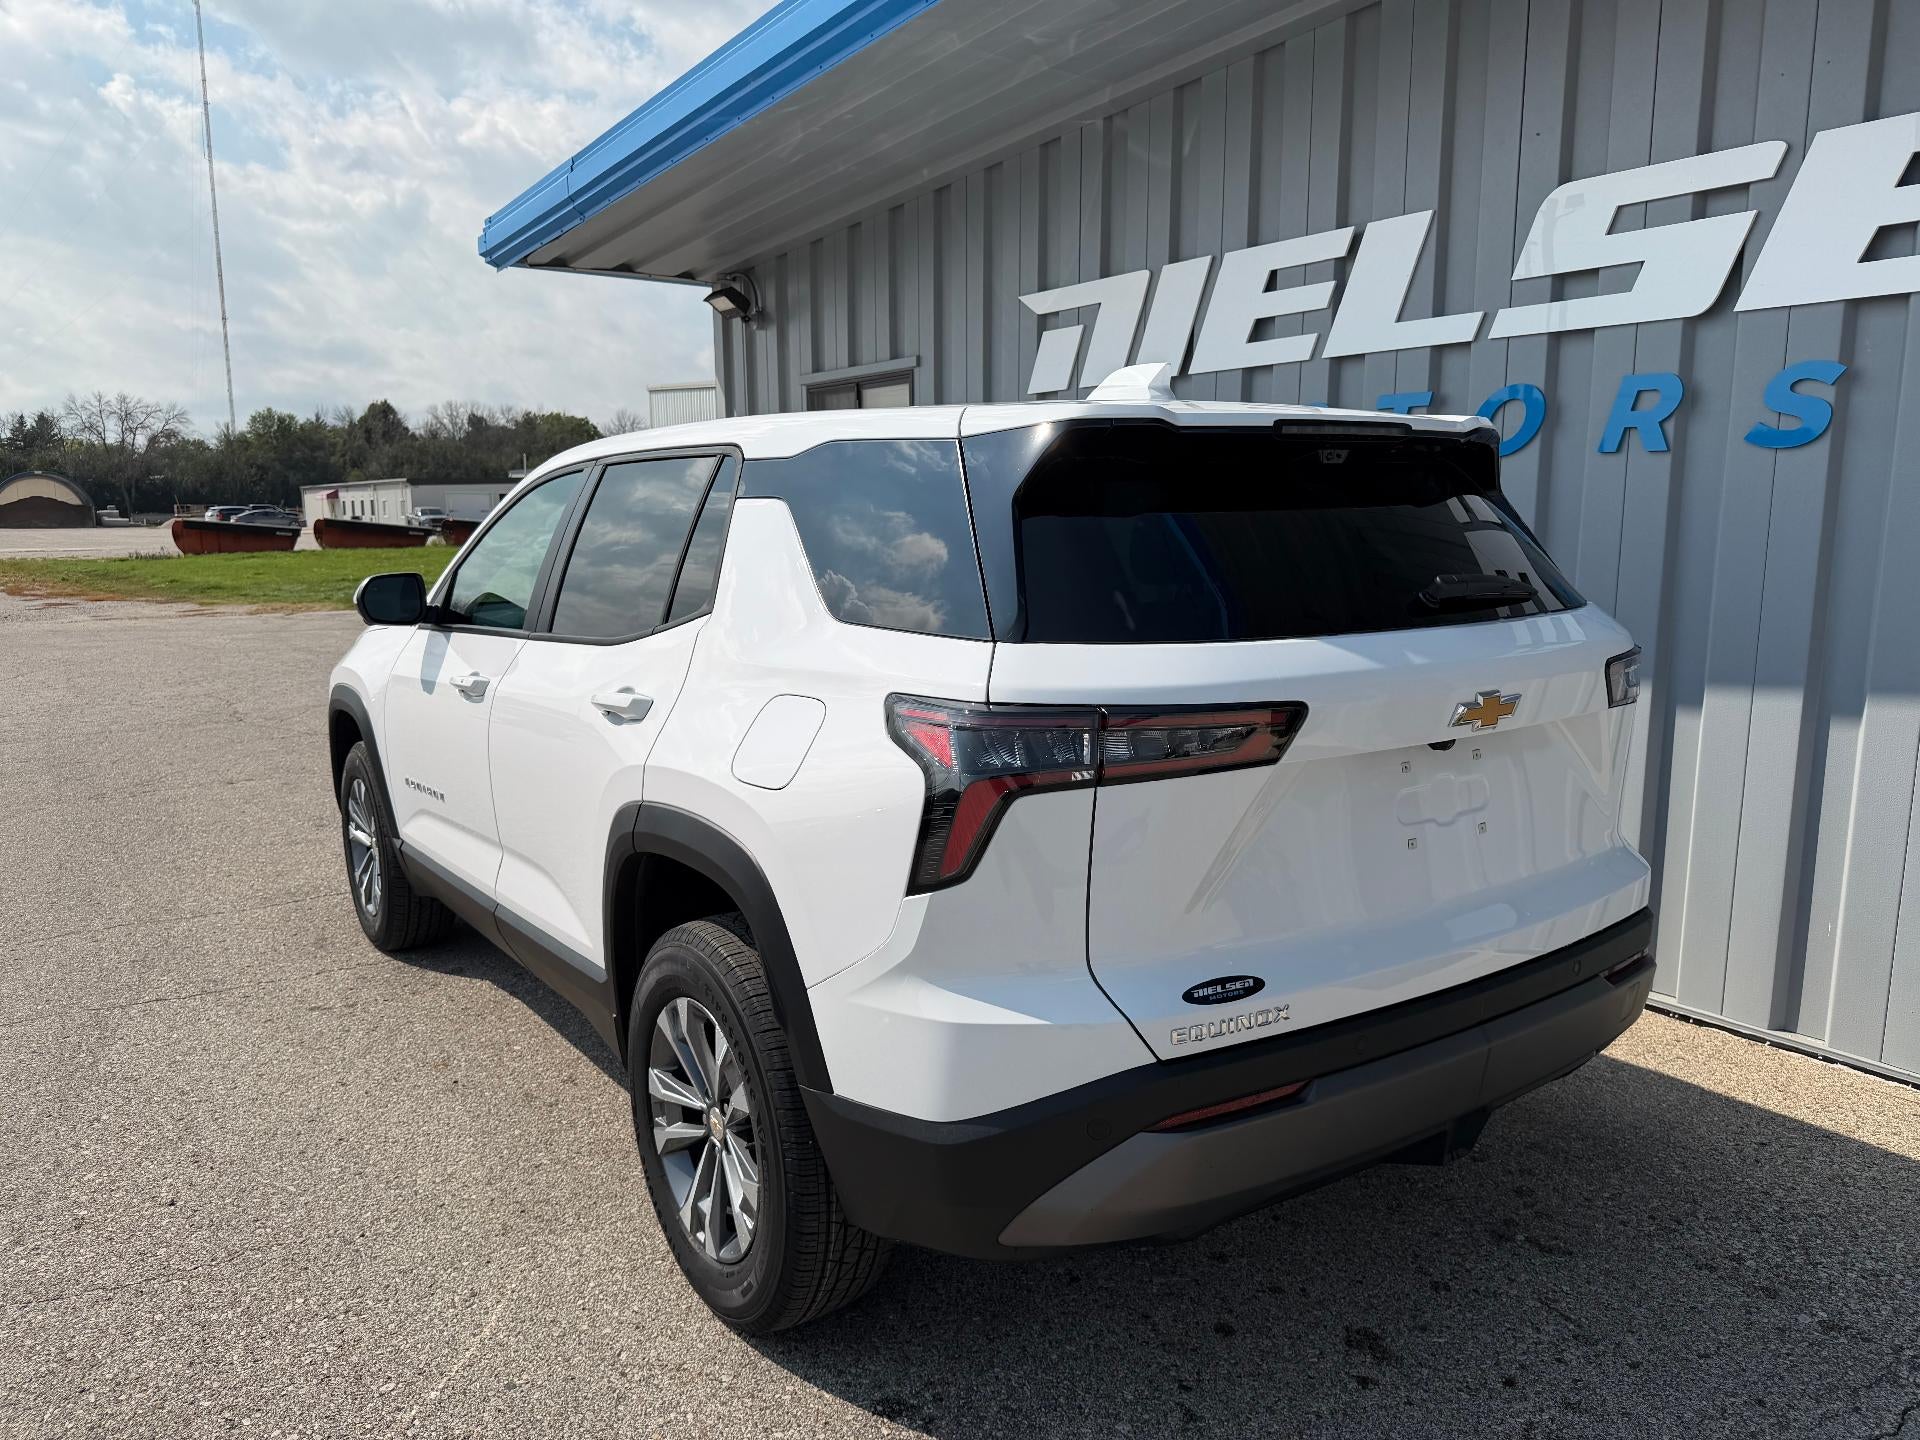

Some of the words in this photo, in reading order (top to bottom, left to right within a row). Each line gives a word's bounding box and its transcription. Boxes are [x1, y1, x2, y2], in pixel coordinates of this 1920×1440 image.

[1191, 979, 1254, 998] NIELSEN
[1209, 990, 1245, 1001] MOTORS
[1170, 1004, 1290, 1045] EQUINOX
